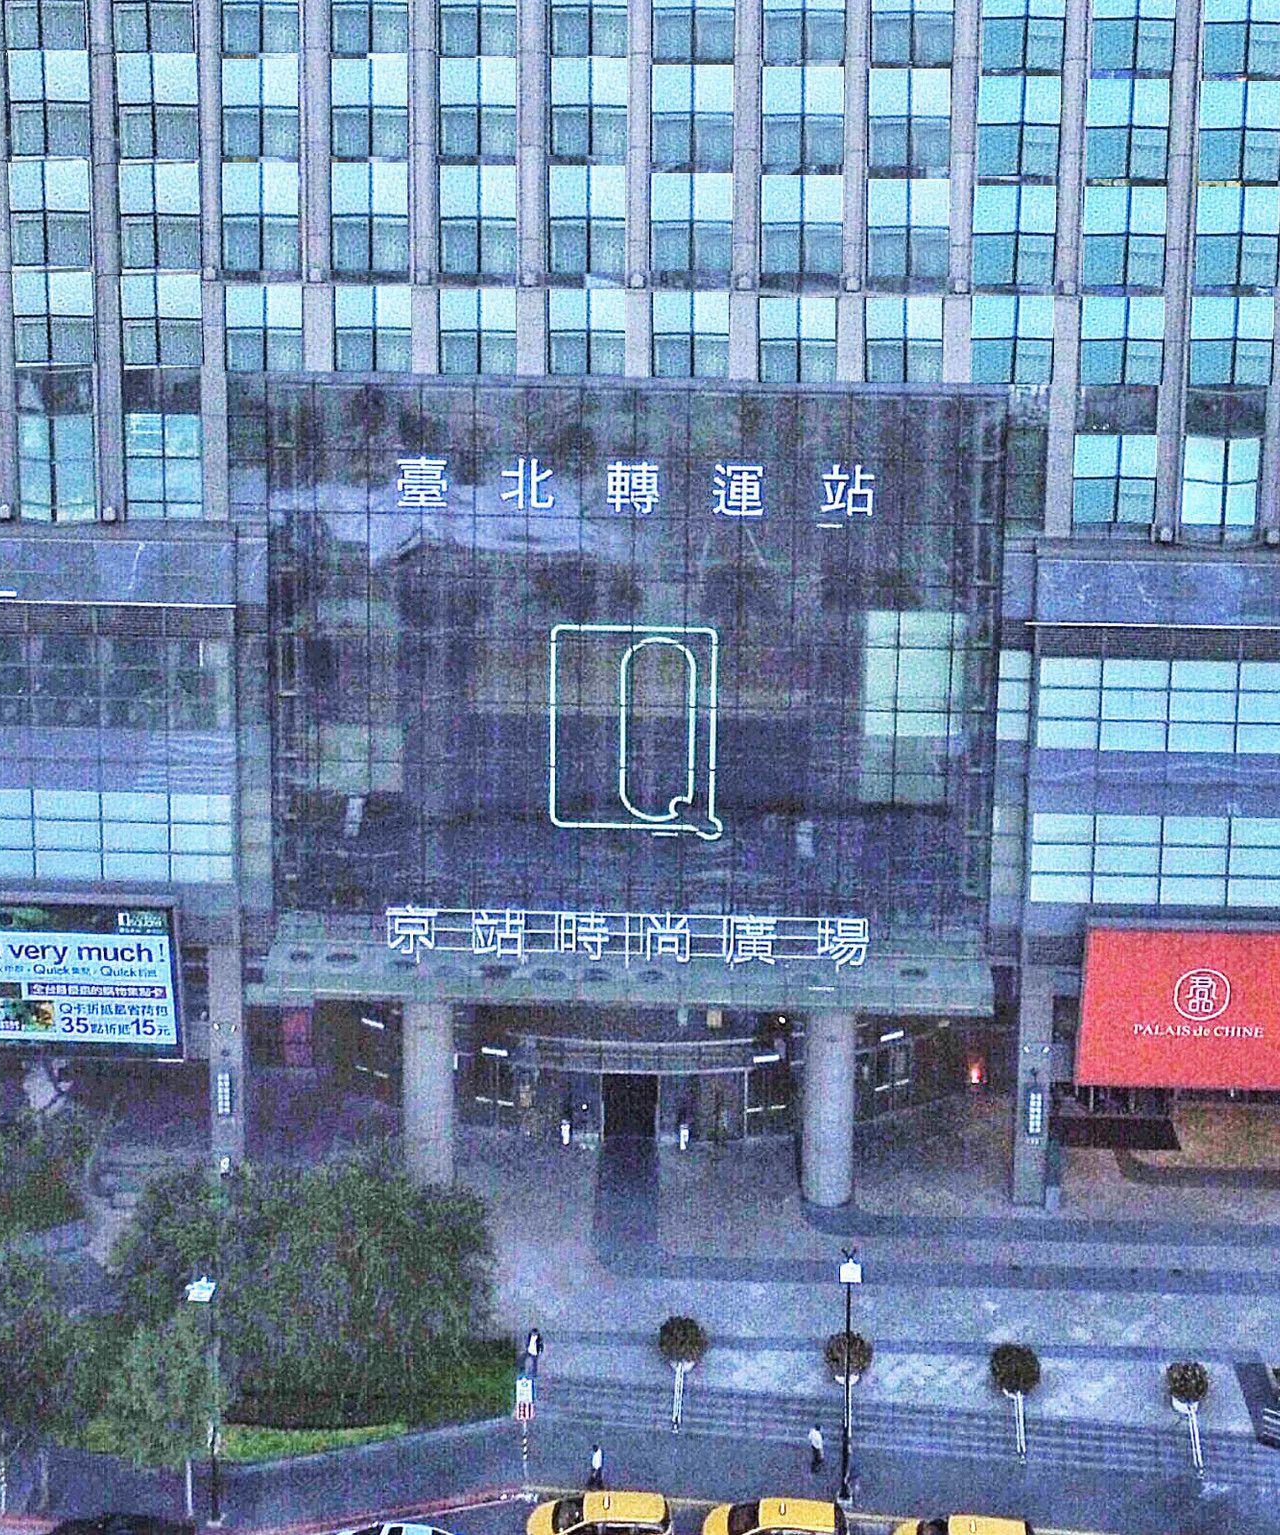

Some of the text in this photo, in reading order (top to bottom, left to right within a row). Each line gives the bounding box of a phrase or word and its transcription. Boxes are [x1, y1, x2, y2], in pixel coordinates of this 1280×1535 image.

[396, 455, 877, 518] 臺北轉運站
[9, 943, 68, 966] very
[386, 904, 869, 967] 京站時尚廣場
[1133, 1024, 1265, 1038] PALAIS de CHINE
